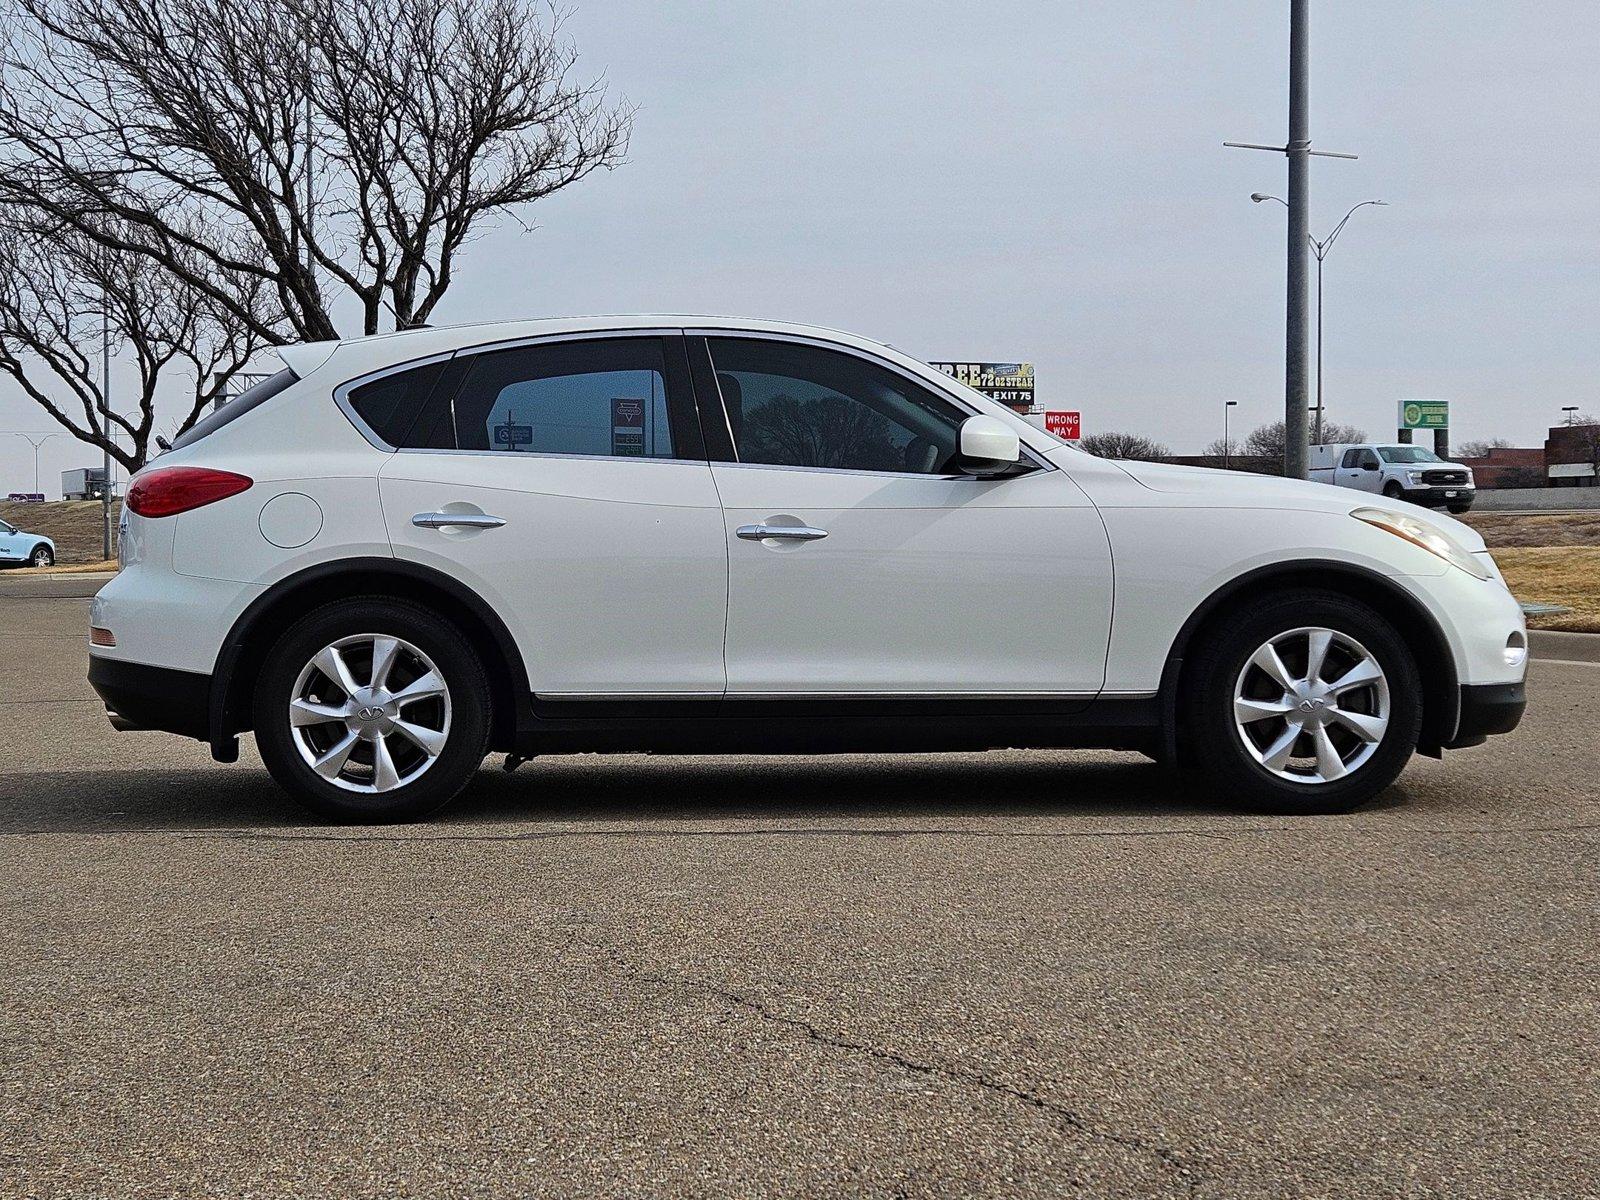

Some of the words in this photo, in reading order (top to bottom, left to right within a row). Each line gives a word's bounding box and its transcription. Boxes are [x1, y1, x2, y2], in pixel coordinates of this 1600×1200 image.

[931, 364, 980, 386] REE
[981, 373, 994, 387] 72
[1006, 376, 1033, 388] STEAK
[993, 391, 1018, 400] EXIT
[1020, 391, 1031, 400] 75
[1047, 415, 1079, 425] WRONG
[1053, 426, 1073, 436] WAY
